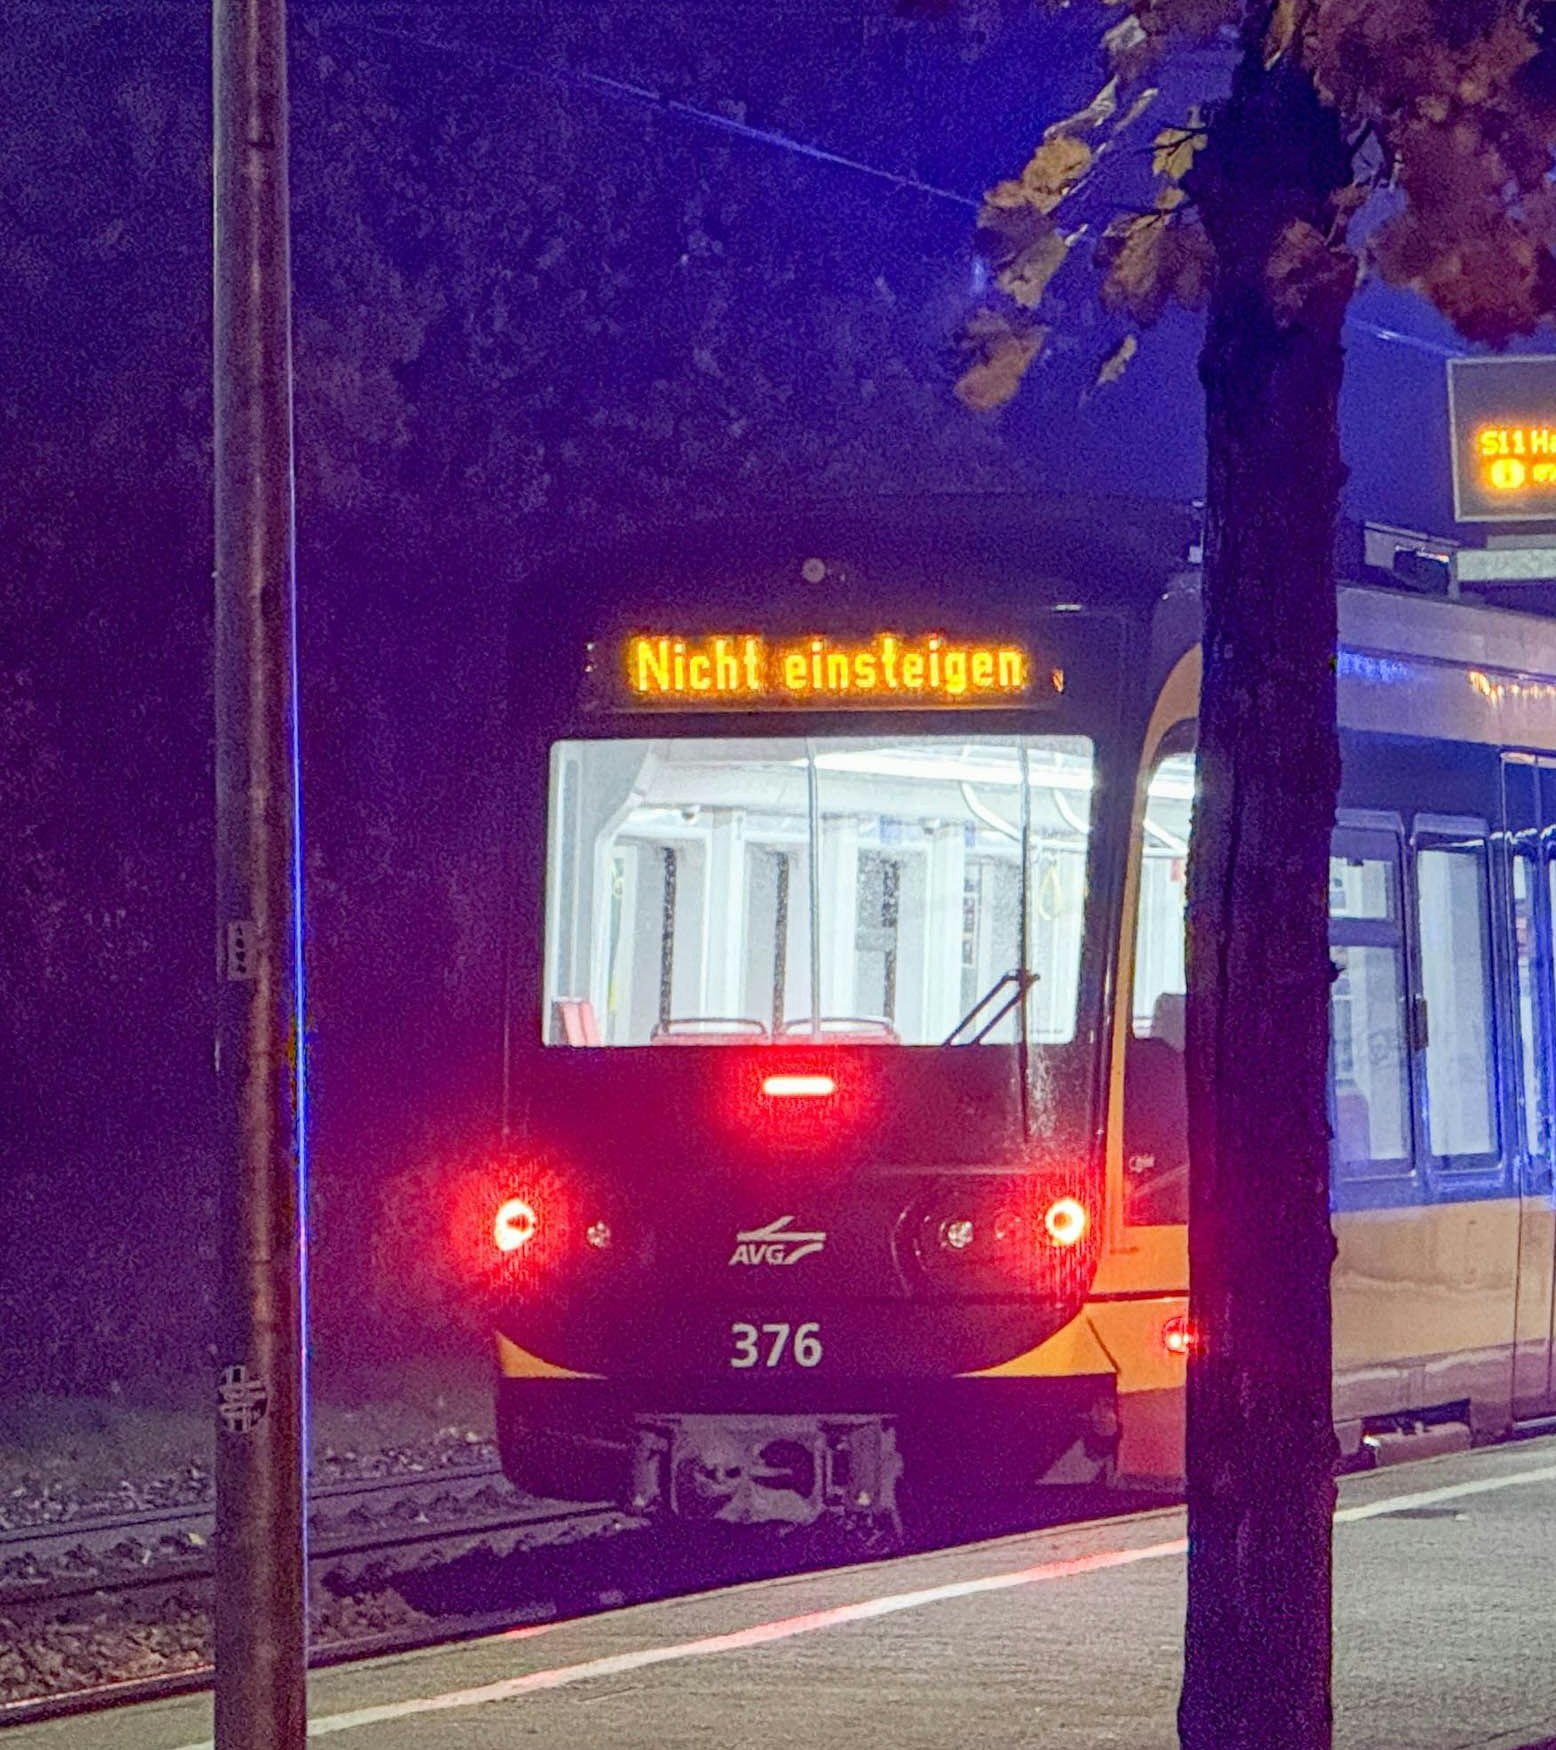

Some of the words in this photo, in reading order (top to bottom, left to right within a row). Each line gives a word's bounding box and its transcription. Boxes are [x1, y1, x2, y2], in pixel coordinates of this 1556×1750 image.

[1480, 430, 1526, 456] S11
[635, 638, 761, 692] Nicht
[783, 637, 1026, 695] einsteigen
[728, 1243, 786, 1265] AVG
[730, 1322, 824, 1368] 376
